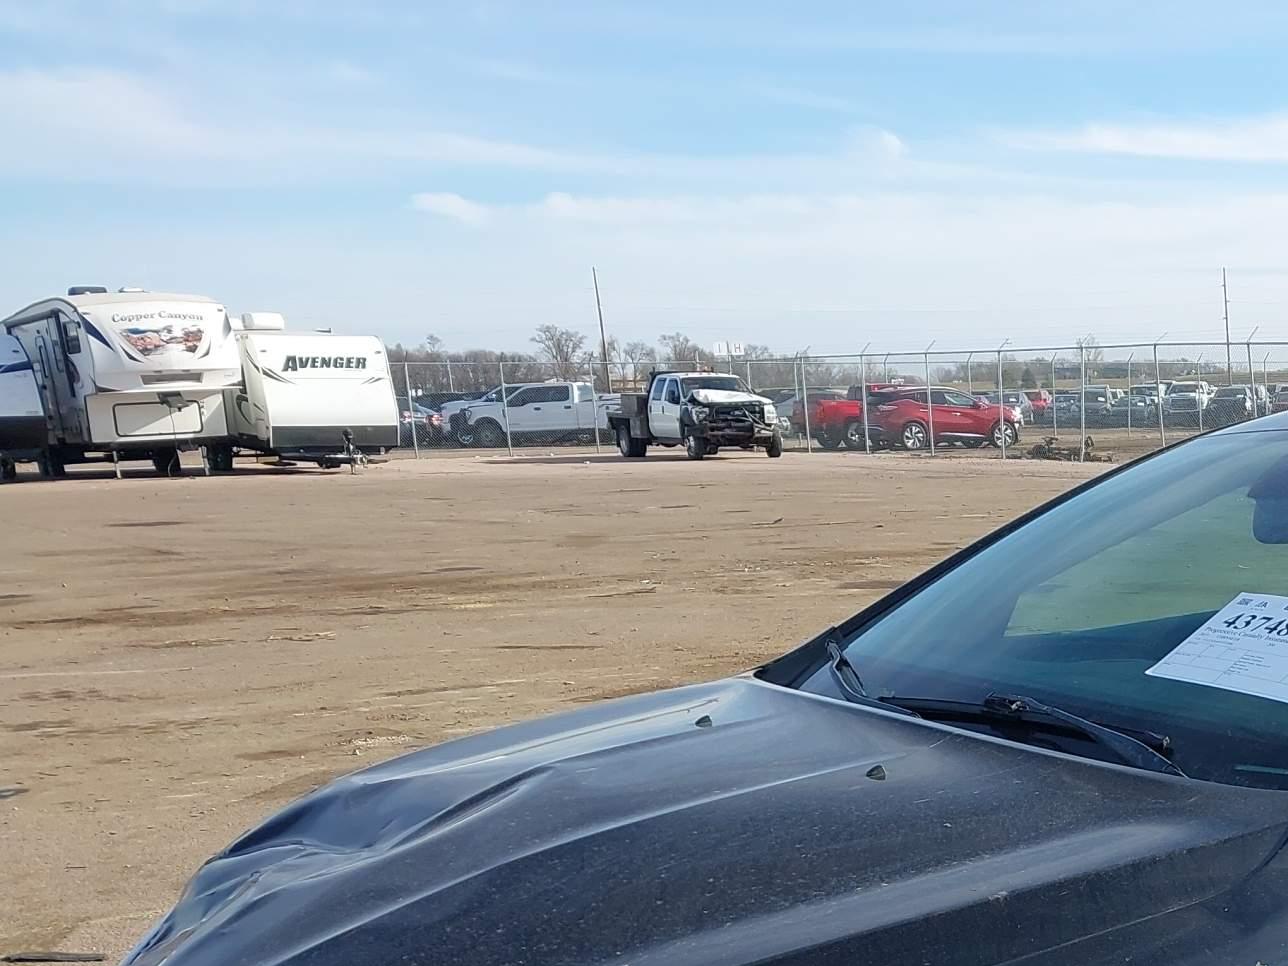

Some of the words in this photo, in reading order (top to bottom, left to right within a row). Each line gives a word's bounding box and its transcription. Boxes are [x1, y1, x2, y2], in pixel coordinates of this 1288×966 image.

[112, 311, 155, 323] Copper
[158, 310, 204, 322] Canyon
[281, 354, 368, 372] AVENGER
